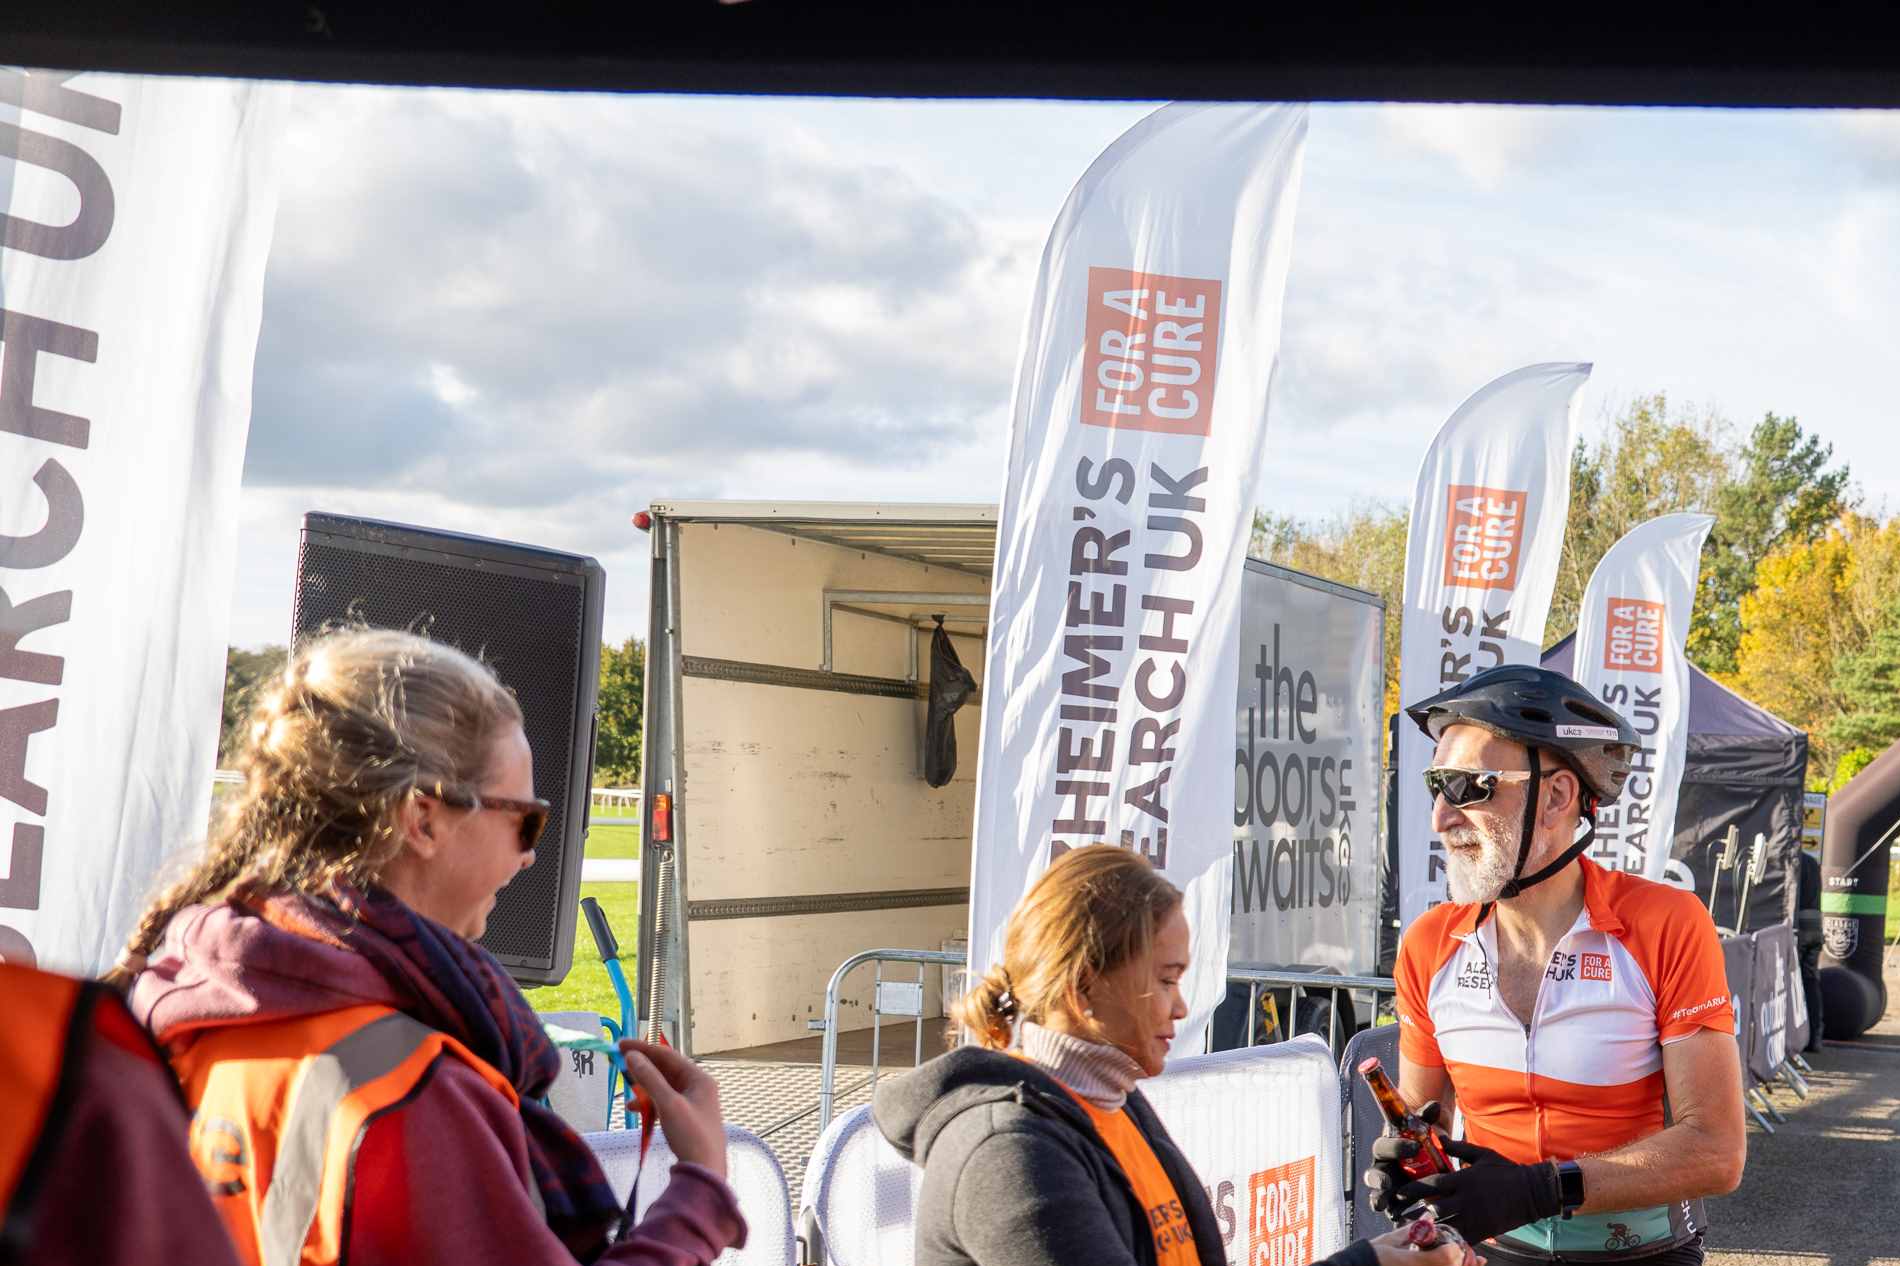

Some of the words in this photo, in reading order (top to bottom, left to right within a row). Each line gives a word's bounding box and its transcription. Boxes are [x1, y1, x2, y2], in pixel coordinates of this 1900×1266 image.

[1103, 287, 1149, 321] A
[1096, 330, 1149, 416] FOR
[1147, 289, 1206, 420] CURE
[1144, 461, 1209, 571] UK
[1455, 496, 1485, 514] A
[1452, 520, 1483, 579] FOR
[1481, 500, 1518, 581] CURE
[1612, 606, 1634, 624] A
[1632, 606, 1663, 668] CURE
[1610, 629, 1633, 664] FOR
[1256, 623, 1318, 745] the
[1634, 685, 1662, 736] UK
[1231, 817, 1335, 914] waits
[1828, 877, 1860, 888] START
[1583, 966, 1611, 980] CURE
[1584, 956, 1601, 967] FOR
[1255, 1181, 1289, 1238] FOR
[1295, 1180, 1310, 1221] A
